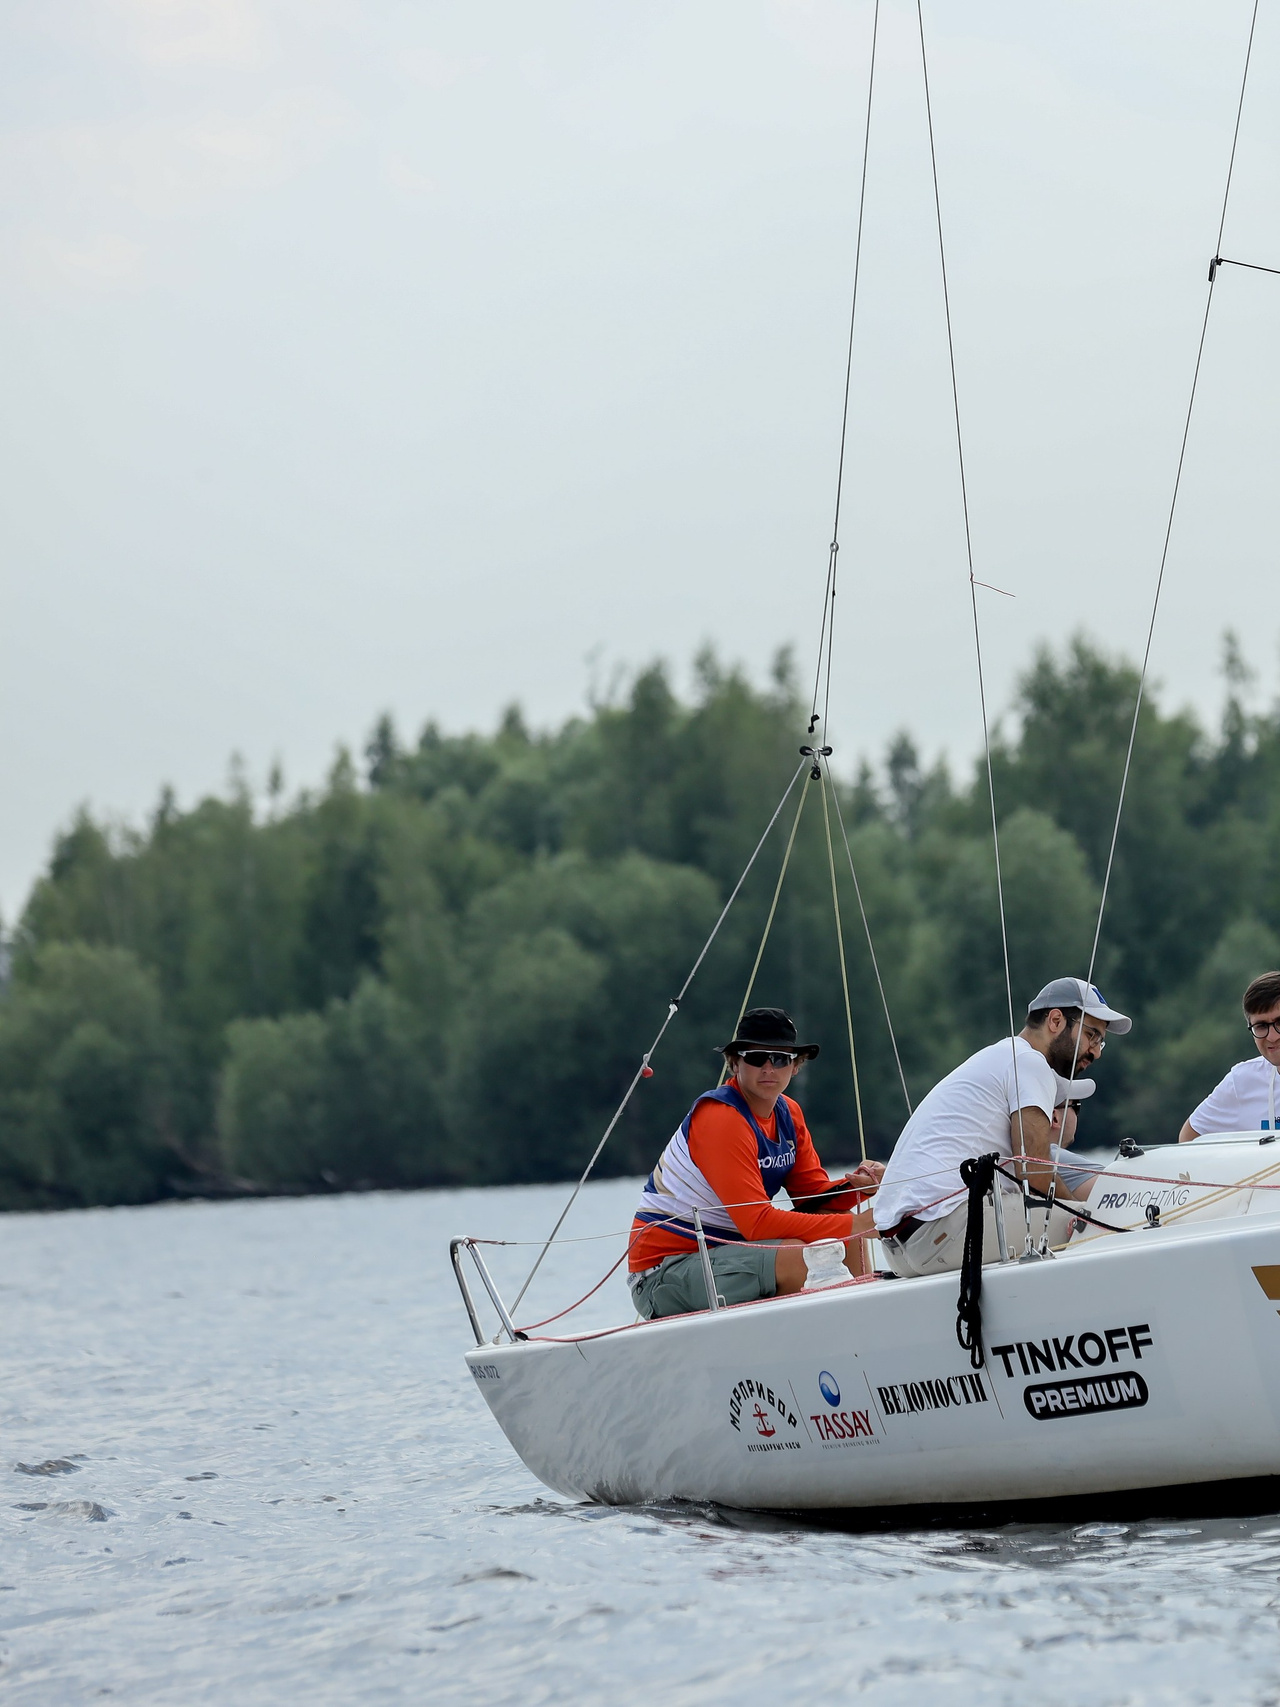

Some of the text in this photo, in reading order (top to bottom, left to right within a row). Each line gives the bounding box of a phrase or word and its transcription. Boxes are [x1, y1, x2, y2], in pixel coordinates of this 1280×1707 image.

[1097, 1189, 1190, 1209] PROYACHTING
[991, 1324, 1154, 1378] TINKOFF
[729, 1379, 798, 1432] МОРПРИБОР
[876, 1373, 989, 1417] ВЕДОМОСТИ
[1029, 1377, 1141, 1414] PREMIUM
[810, 1409, 875, 1441] TASSAY
